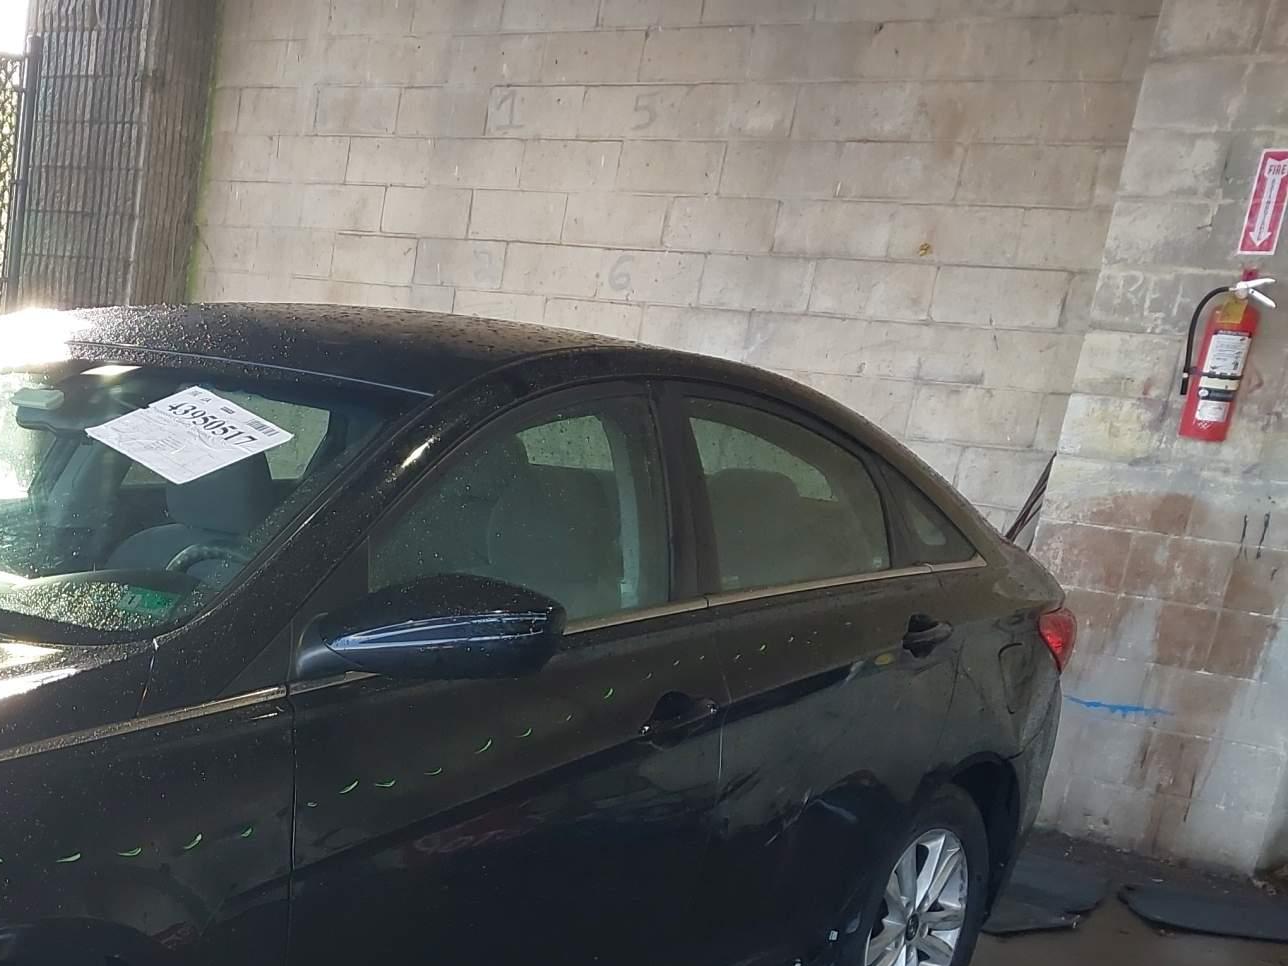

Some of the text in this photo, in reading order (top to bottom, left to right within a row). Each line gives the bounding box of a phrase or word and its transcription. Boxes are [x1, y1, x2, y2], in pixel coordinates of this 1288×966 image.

[630, 90, 661, 131] 5
[1267, 164, 1288, 176] FIRE
[608, 255, 633, 291] 6
[167, 402, 258, 446] 43950517
